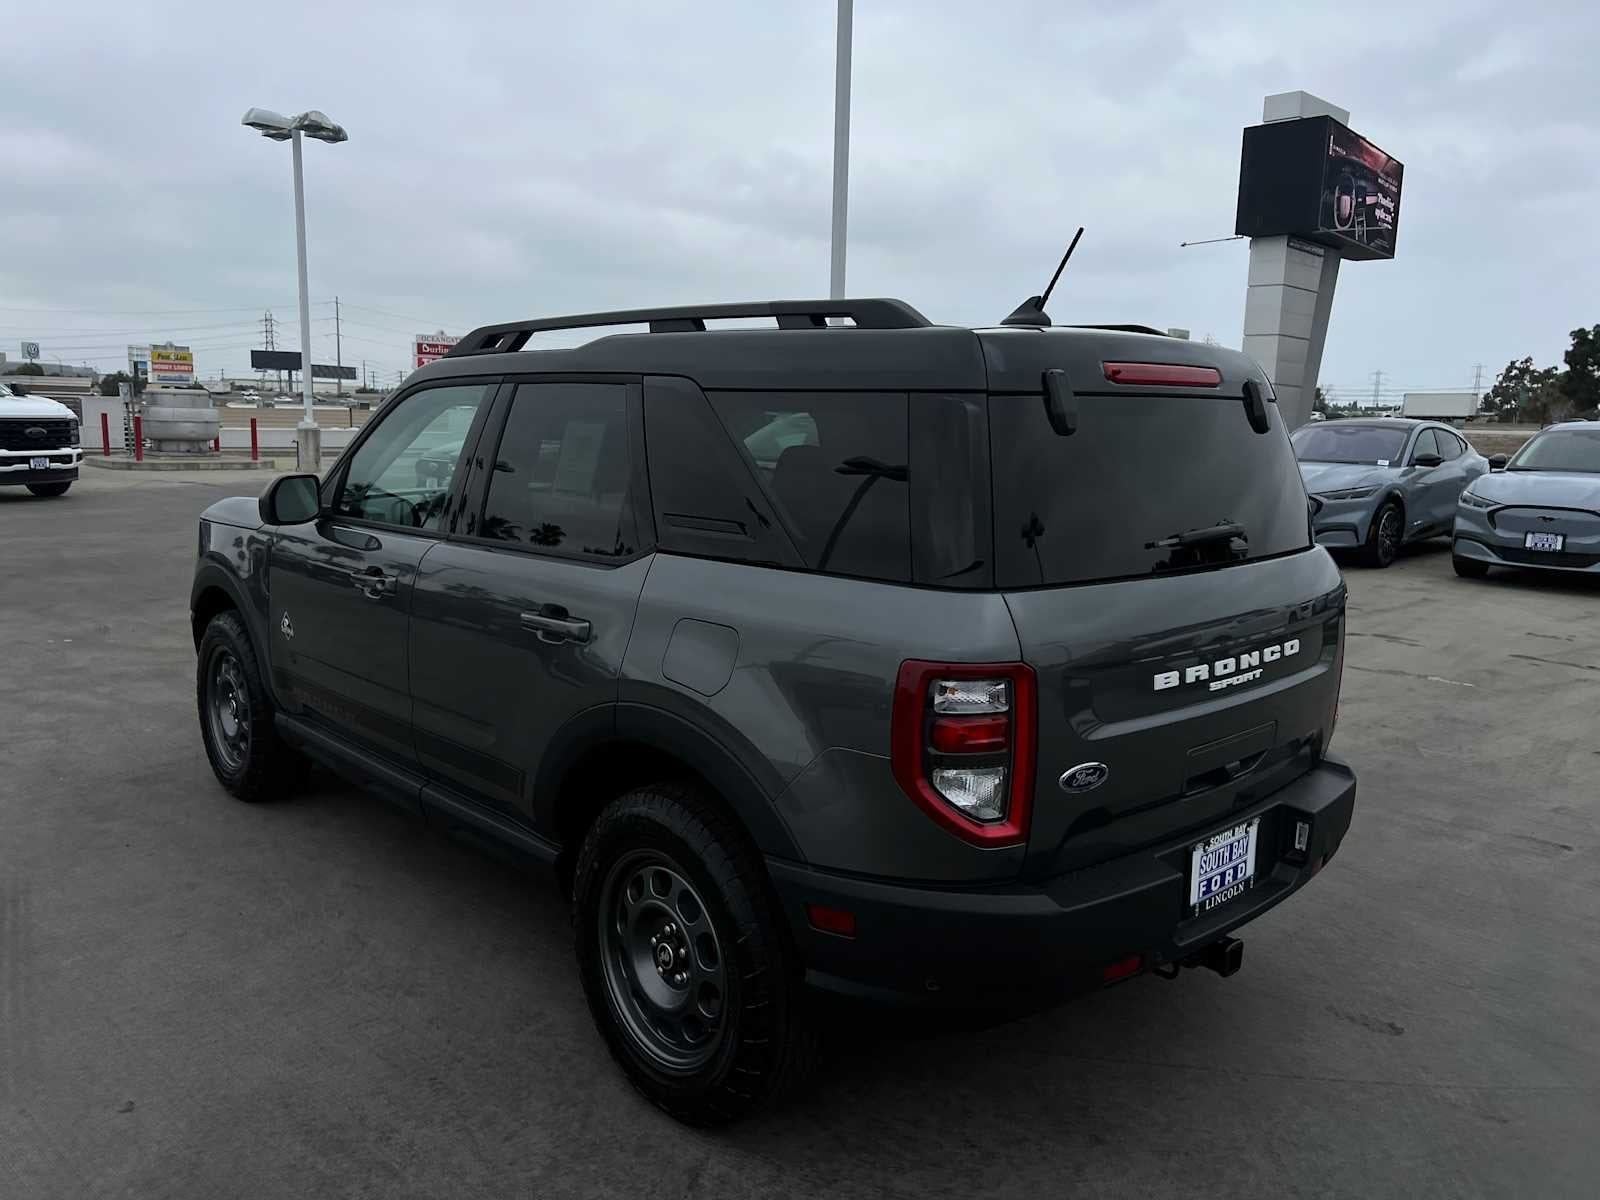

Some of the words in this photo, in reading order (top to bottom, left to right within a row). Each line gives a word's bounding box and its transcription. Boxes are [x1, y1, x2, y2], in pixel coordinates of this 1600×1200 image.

[1153, 639, 1300, 690] BRONCO
[1208, 668, 1263, 691] SPORT
[1210, 829, 1233, 845] SOUTH
[1234, 823, 1248, 834] BAY
[1200, 844, 1231, 874] SOUTH
[1232, 836, 1249, 860] BAY
[1199, 862, 1246, 898] FORD
[1205, 881, 1245, 910] LINCOLN
